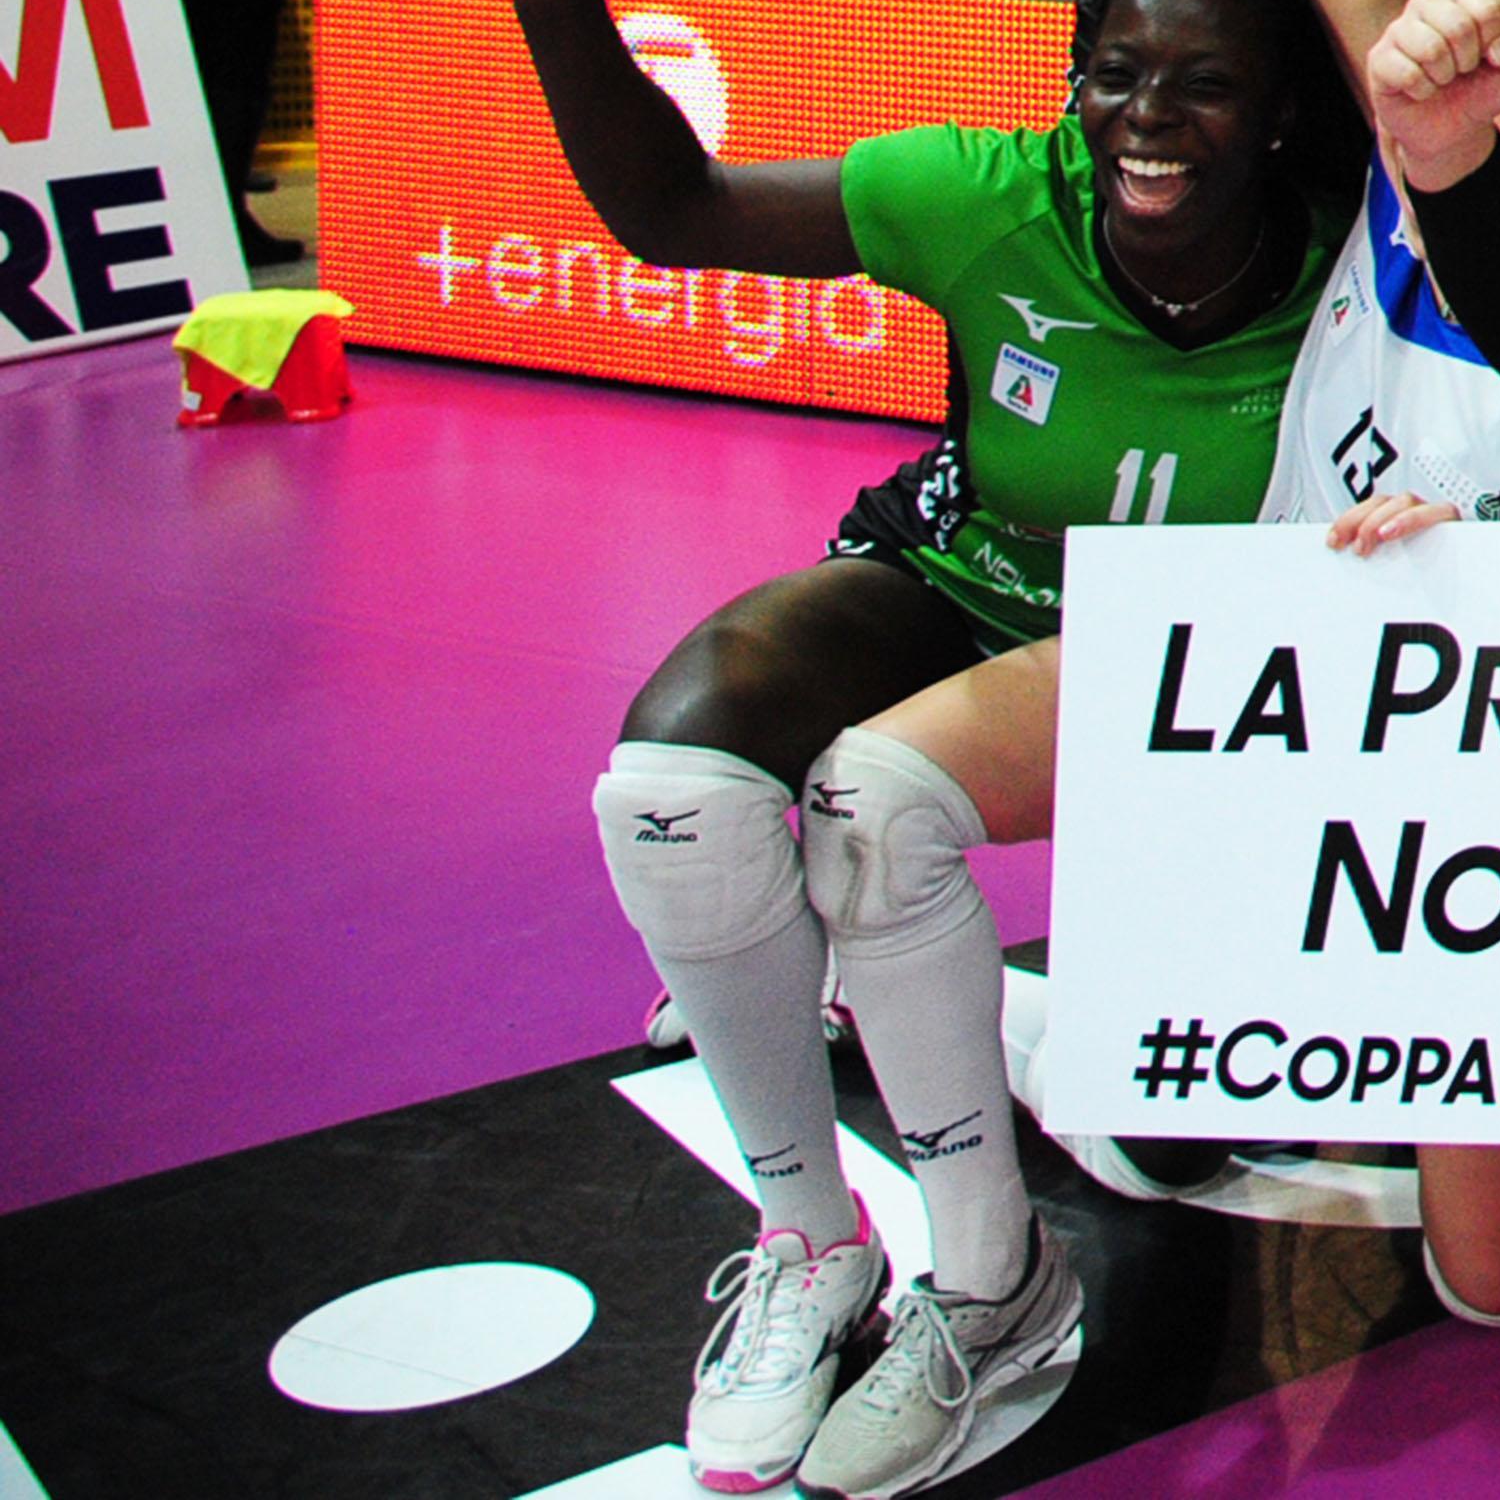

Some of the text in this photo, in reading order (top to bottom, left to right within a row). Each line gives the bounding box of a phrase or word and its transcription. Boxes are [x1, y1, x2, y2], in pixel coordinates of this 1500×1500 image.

[1003, 348, 1055, 379] SAMSUNG
[1108, 448, 1178, 526] 11
[1331, 404, 1399, 504] 13
